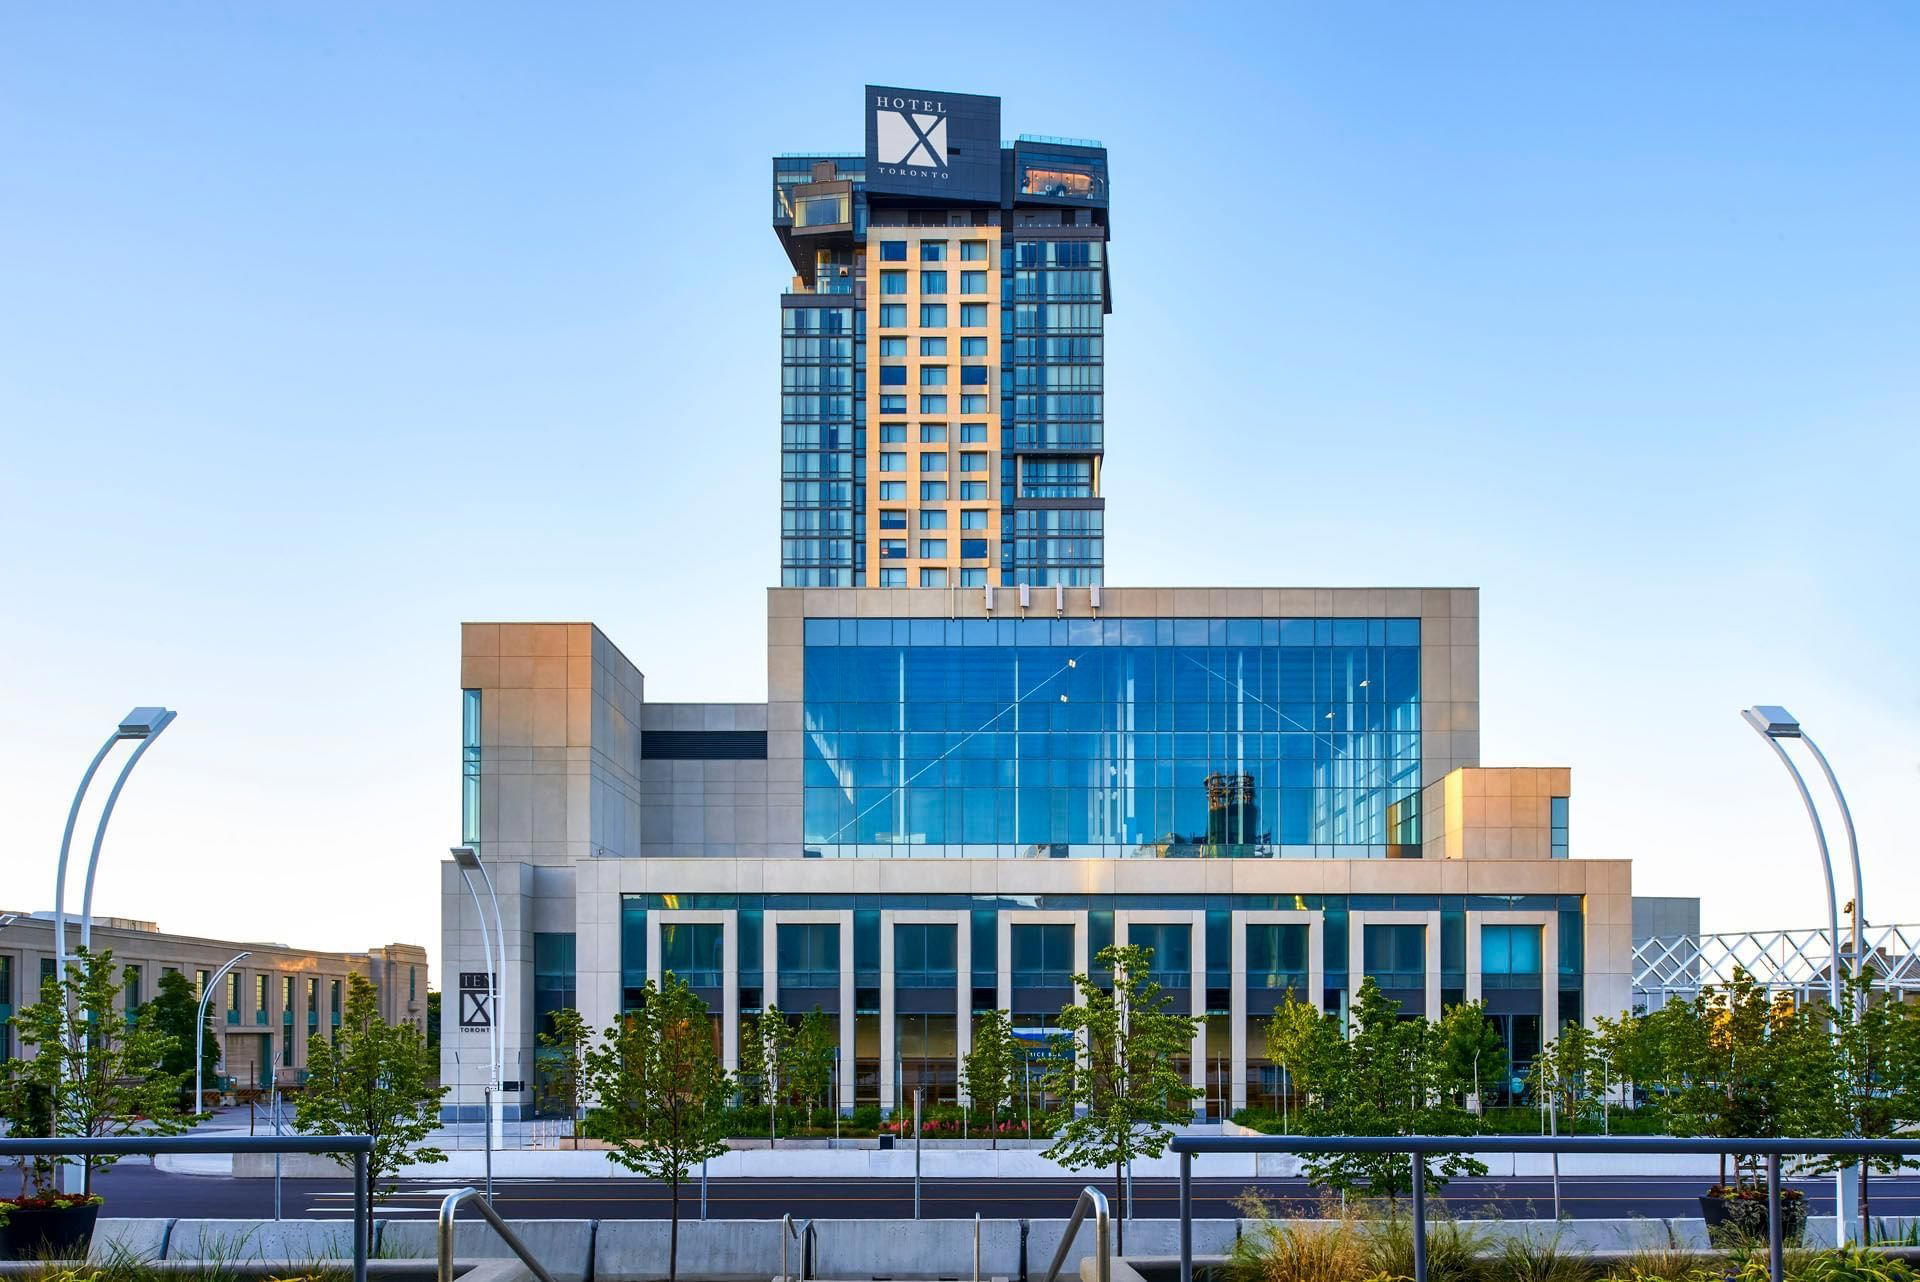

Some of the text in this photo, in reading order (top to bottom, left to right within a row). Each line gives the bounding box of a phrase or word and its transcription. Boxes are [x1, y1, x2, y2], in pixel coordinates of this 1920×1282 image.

[876, 96, 947, 113] HOTEL
[890, 110, 948, 168] X
[878, 167, 949, 179] TORONTO
